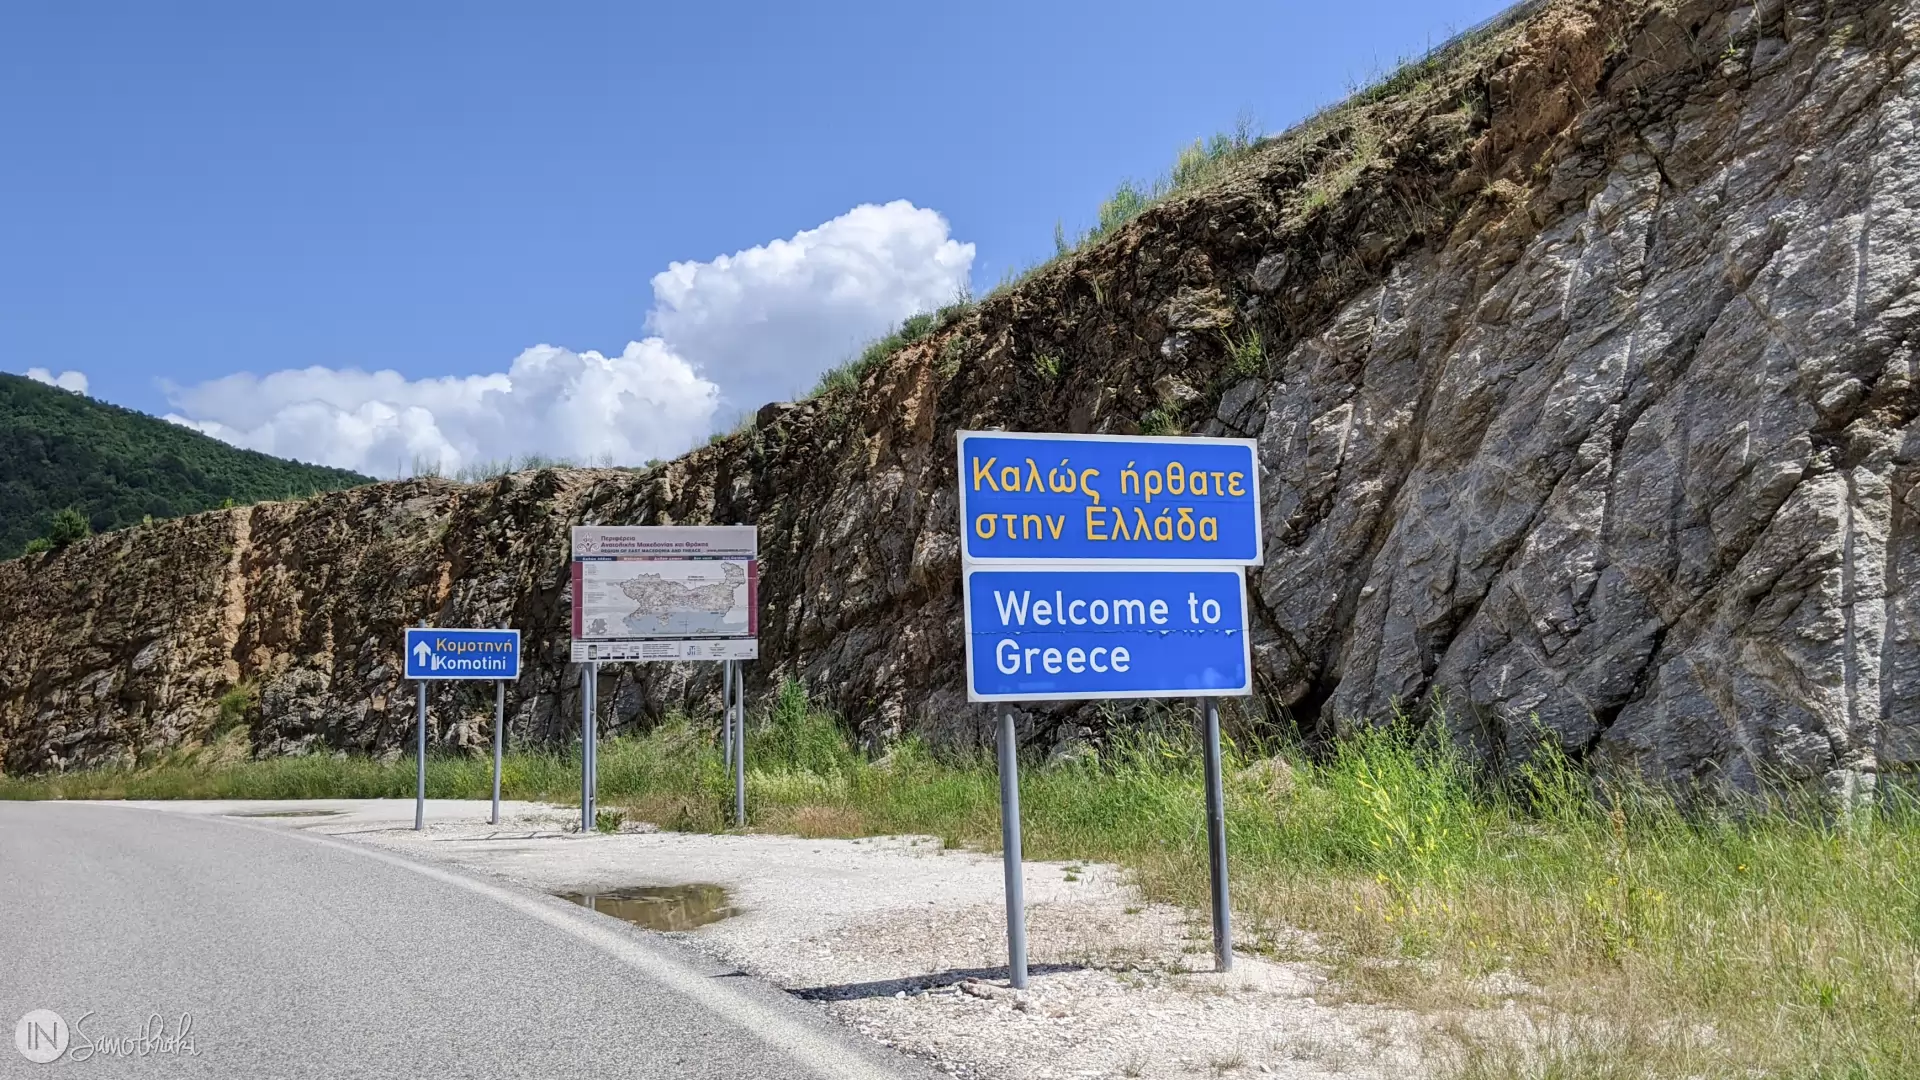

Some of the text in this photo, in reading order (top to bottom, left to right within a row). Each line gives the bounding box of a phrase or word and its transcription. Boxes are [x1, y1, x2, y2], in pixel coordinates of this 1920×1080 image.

[972, 456, 1246, 504] Καλώς ήρθατε
[975, 506, 1218, 542] στην Ελλάδα
[993, 590, 1222, 626] Welcome to
[436, 638, 513, 655] Κομοτηνή
[436, 655, 506, 670] Komotini
[995, 638, 1131, 675] Greece
